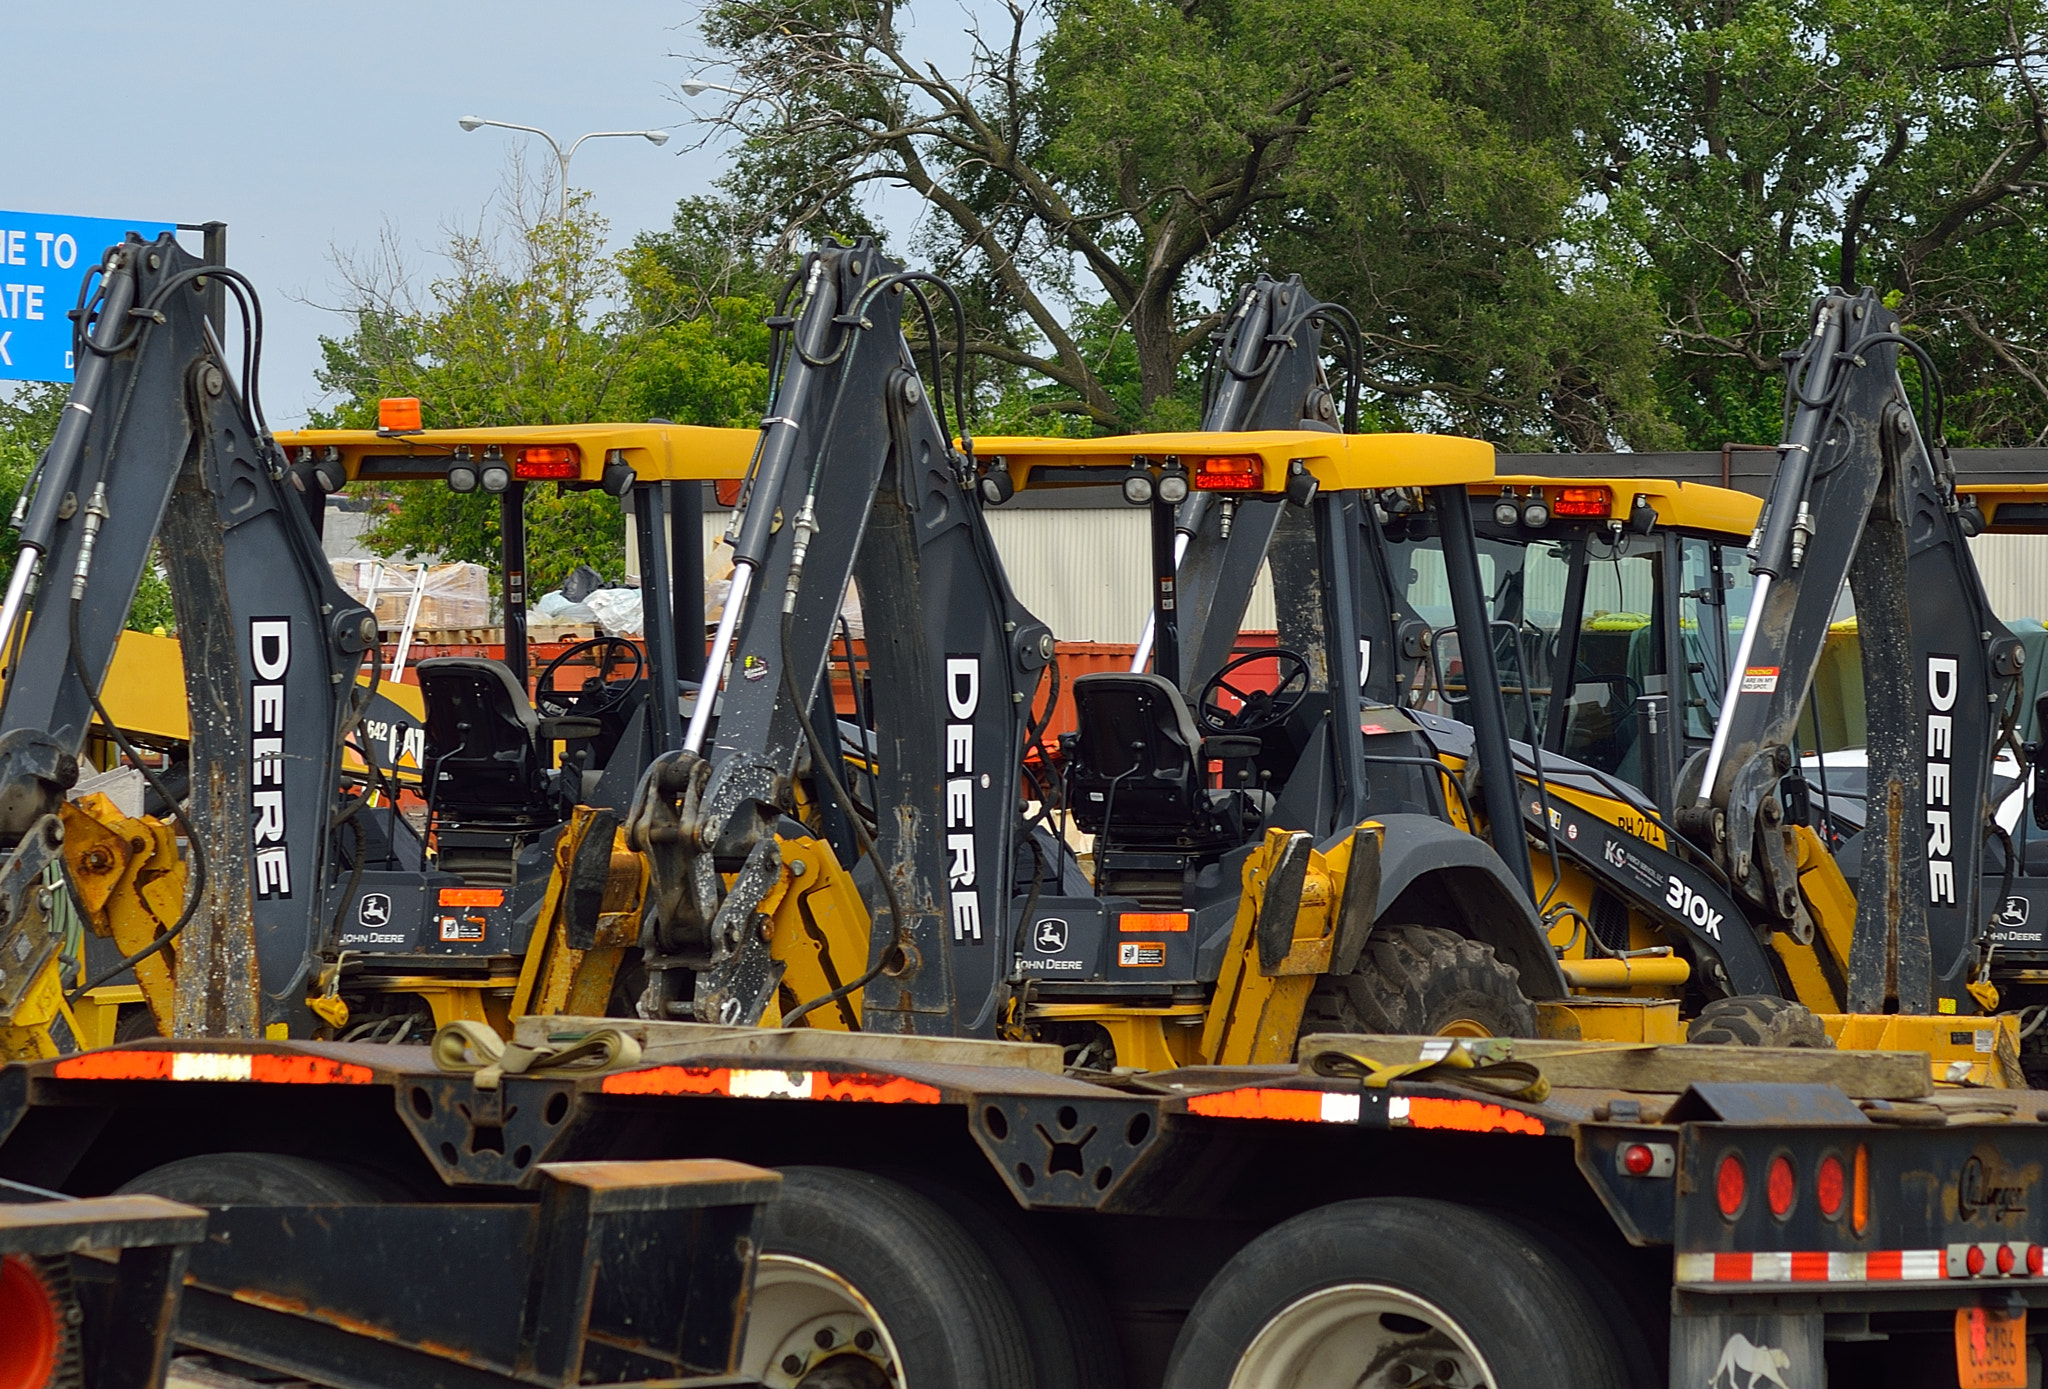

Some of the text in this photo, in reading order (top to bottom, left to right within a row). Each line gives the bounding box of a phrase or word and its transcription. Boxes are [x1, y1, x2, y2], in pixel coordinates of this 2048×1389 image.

[35, 232, 77, 269] TO
[252, 621, 289, 895] DEERE
[1926, 657, 1957, 904] DEERE
[946, 658, 981, 941] DEERE
[1637, 817, 1660, 842] 271
[1604, 840, 1626, 868] KS
[1665, 875, 1724, 941] 310K
[369, 932, 405, 943] DEERE
[2009, 931, 2043, 941] DEERE
[1046, 958, 1083, 970] DEERE
